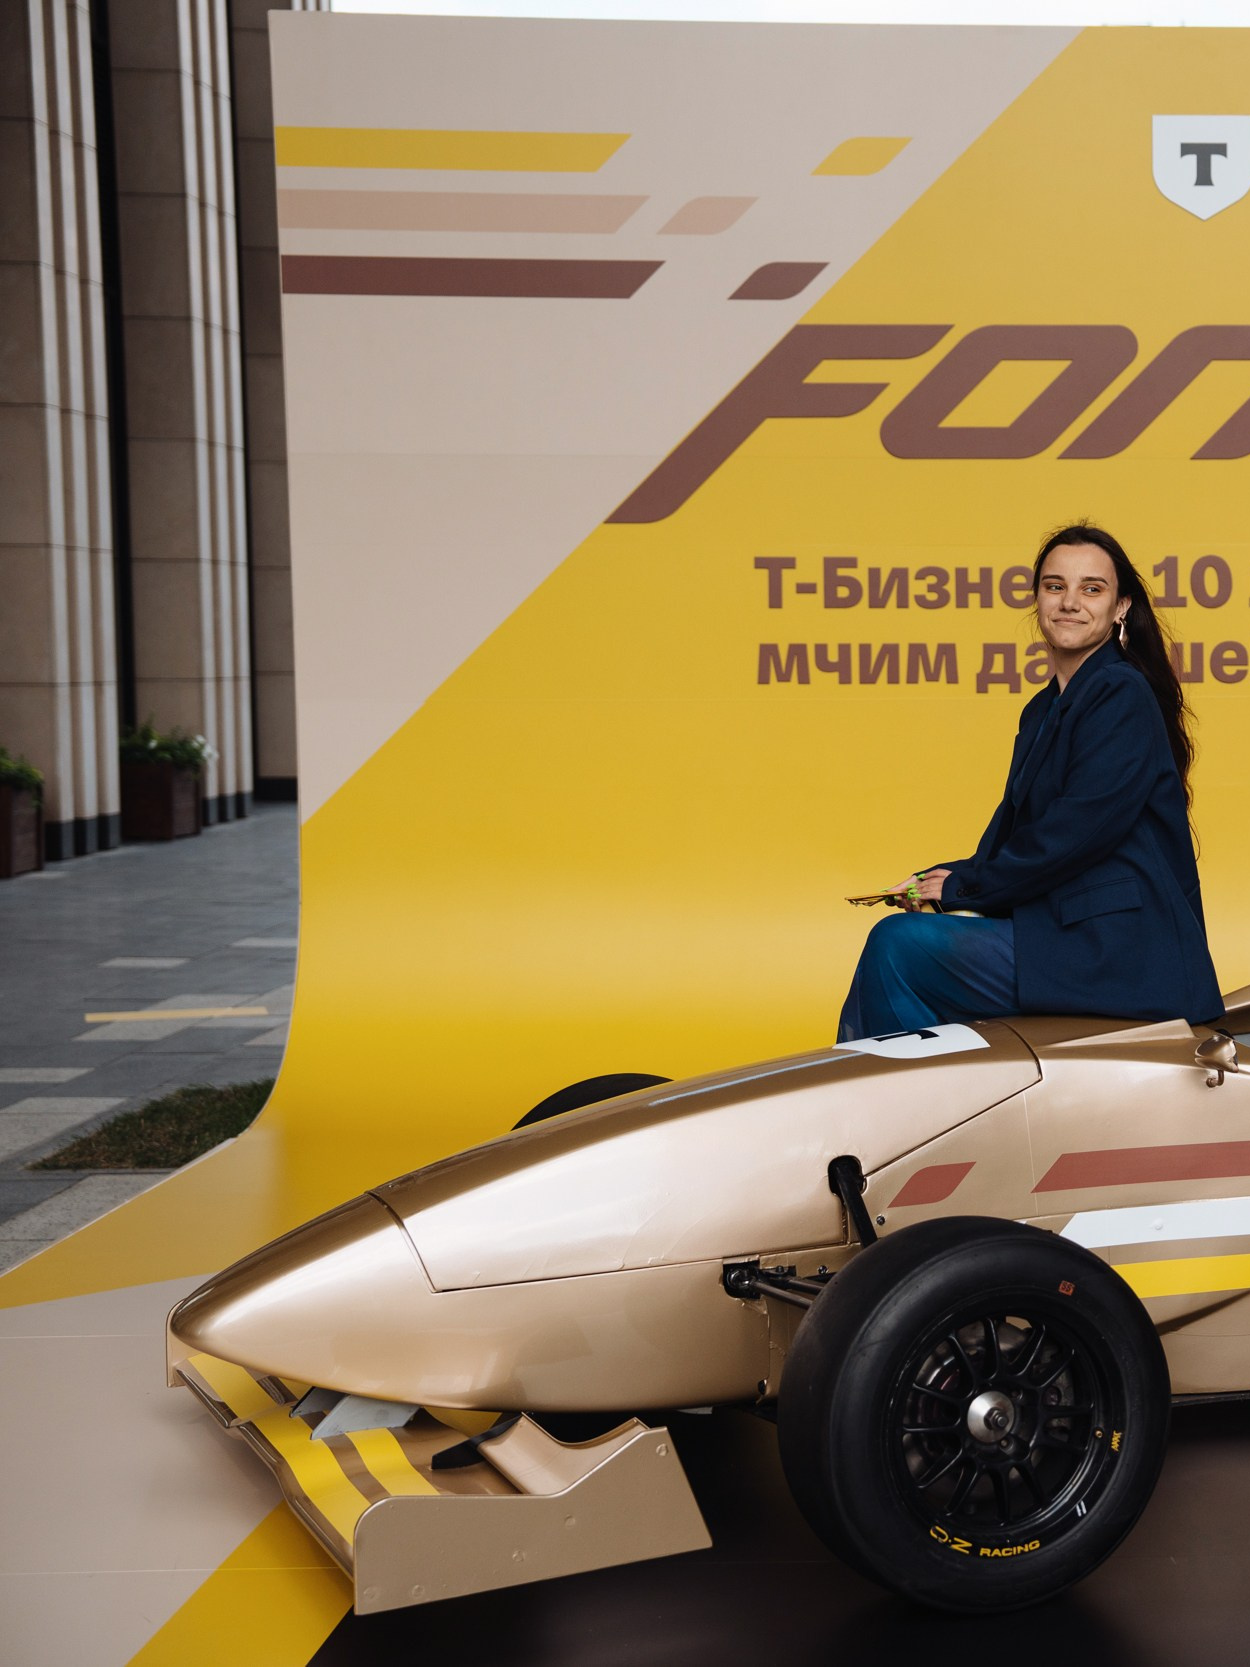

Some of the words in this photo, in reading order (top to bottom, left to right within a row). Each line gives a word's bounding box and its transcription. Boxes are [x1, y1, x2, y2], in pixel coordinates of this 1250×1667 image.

[754, 556, 1036, 610] Т-Бизне
[1153, 555, 1233, 609] 10
[757, 643, 959, 685] мчим
[979, 1539, 1041, 1557] RACING
